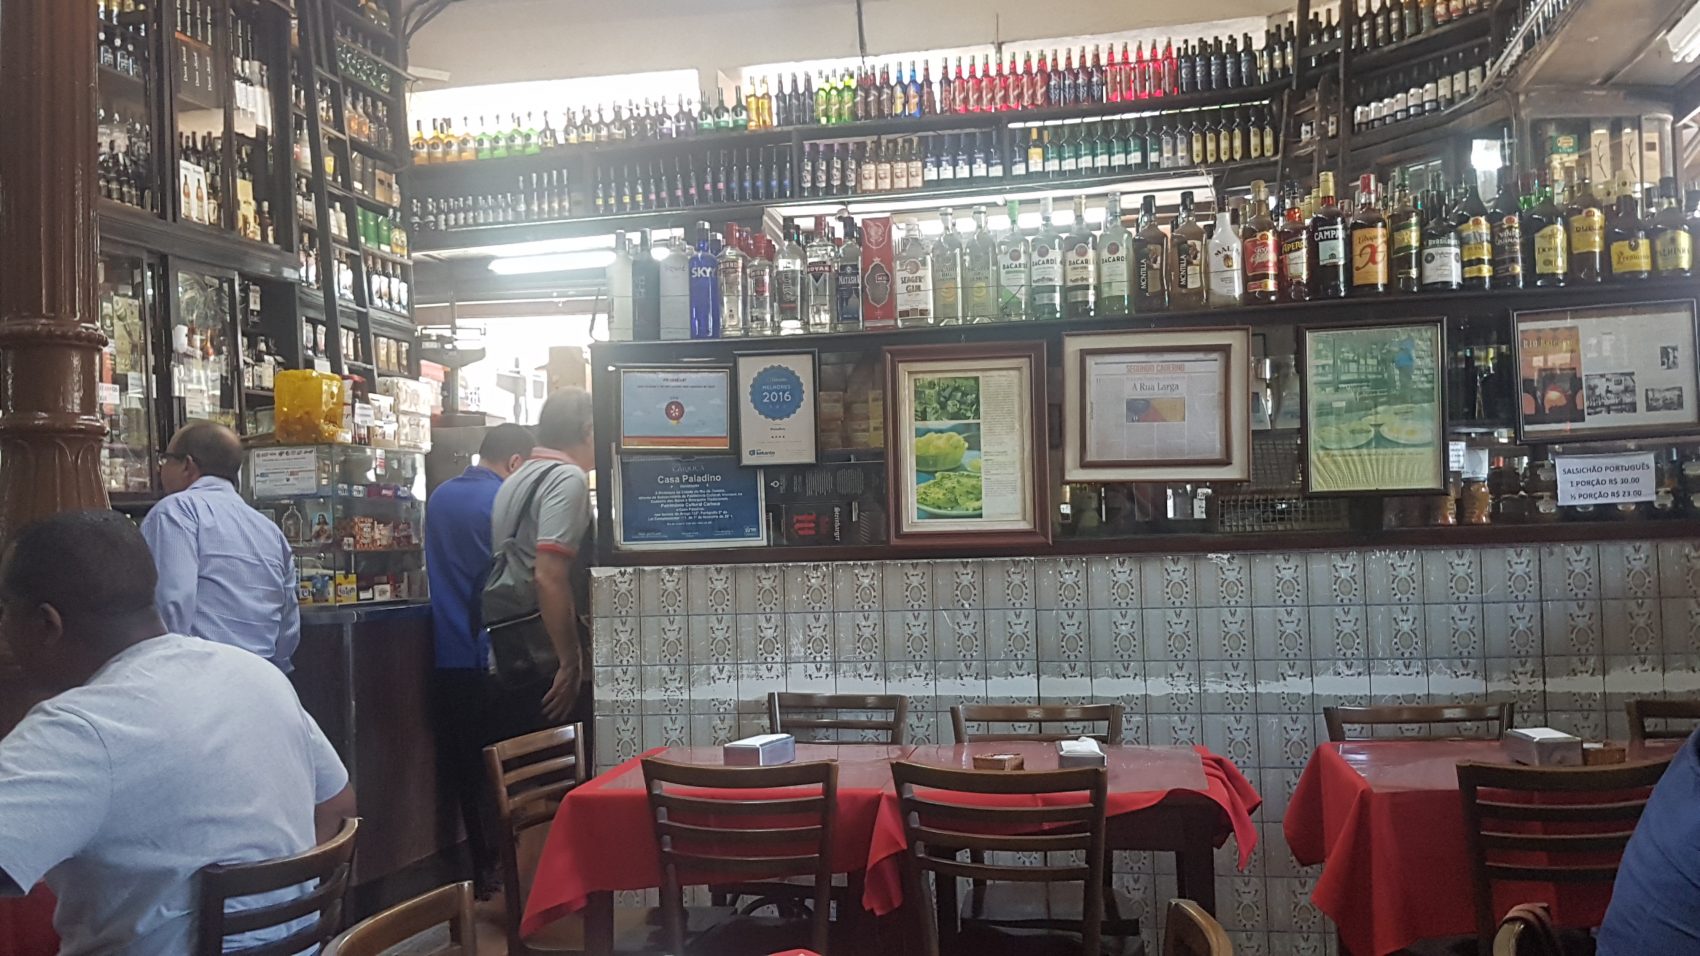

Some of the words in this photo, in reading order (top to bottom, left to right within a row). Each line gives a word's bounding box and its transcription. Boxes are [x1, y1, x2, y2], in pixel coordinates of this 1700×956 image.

[691, 267, 715, 278] SKYY
[1132, 383, 1138, 391] A
[1139, 382, 1155, 391] Rua
[1157, 382, 1179, 392] Larga
[763, 391, 792, 403] 2016
[1562, 465, 1603, 475] SALSICHÃO
[1604, 462, 1650, 473] PORTUGUÊS
[657, 475, 680, 484] Casa
[682, 473, 722, 483] Paladino
[1575, 478, 1607, 487] PORÇÃO
[1608, 478, 1618, 486] R$
[1578, 491, 1609, 500] PORÇÃO
[1610, 490, 1620, 498] R$
